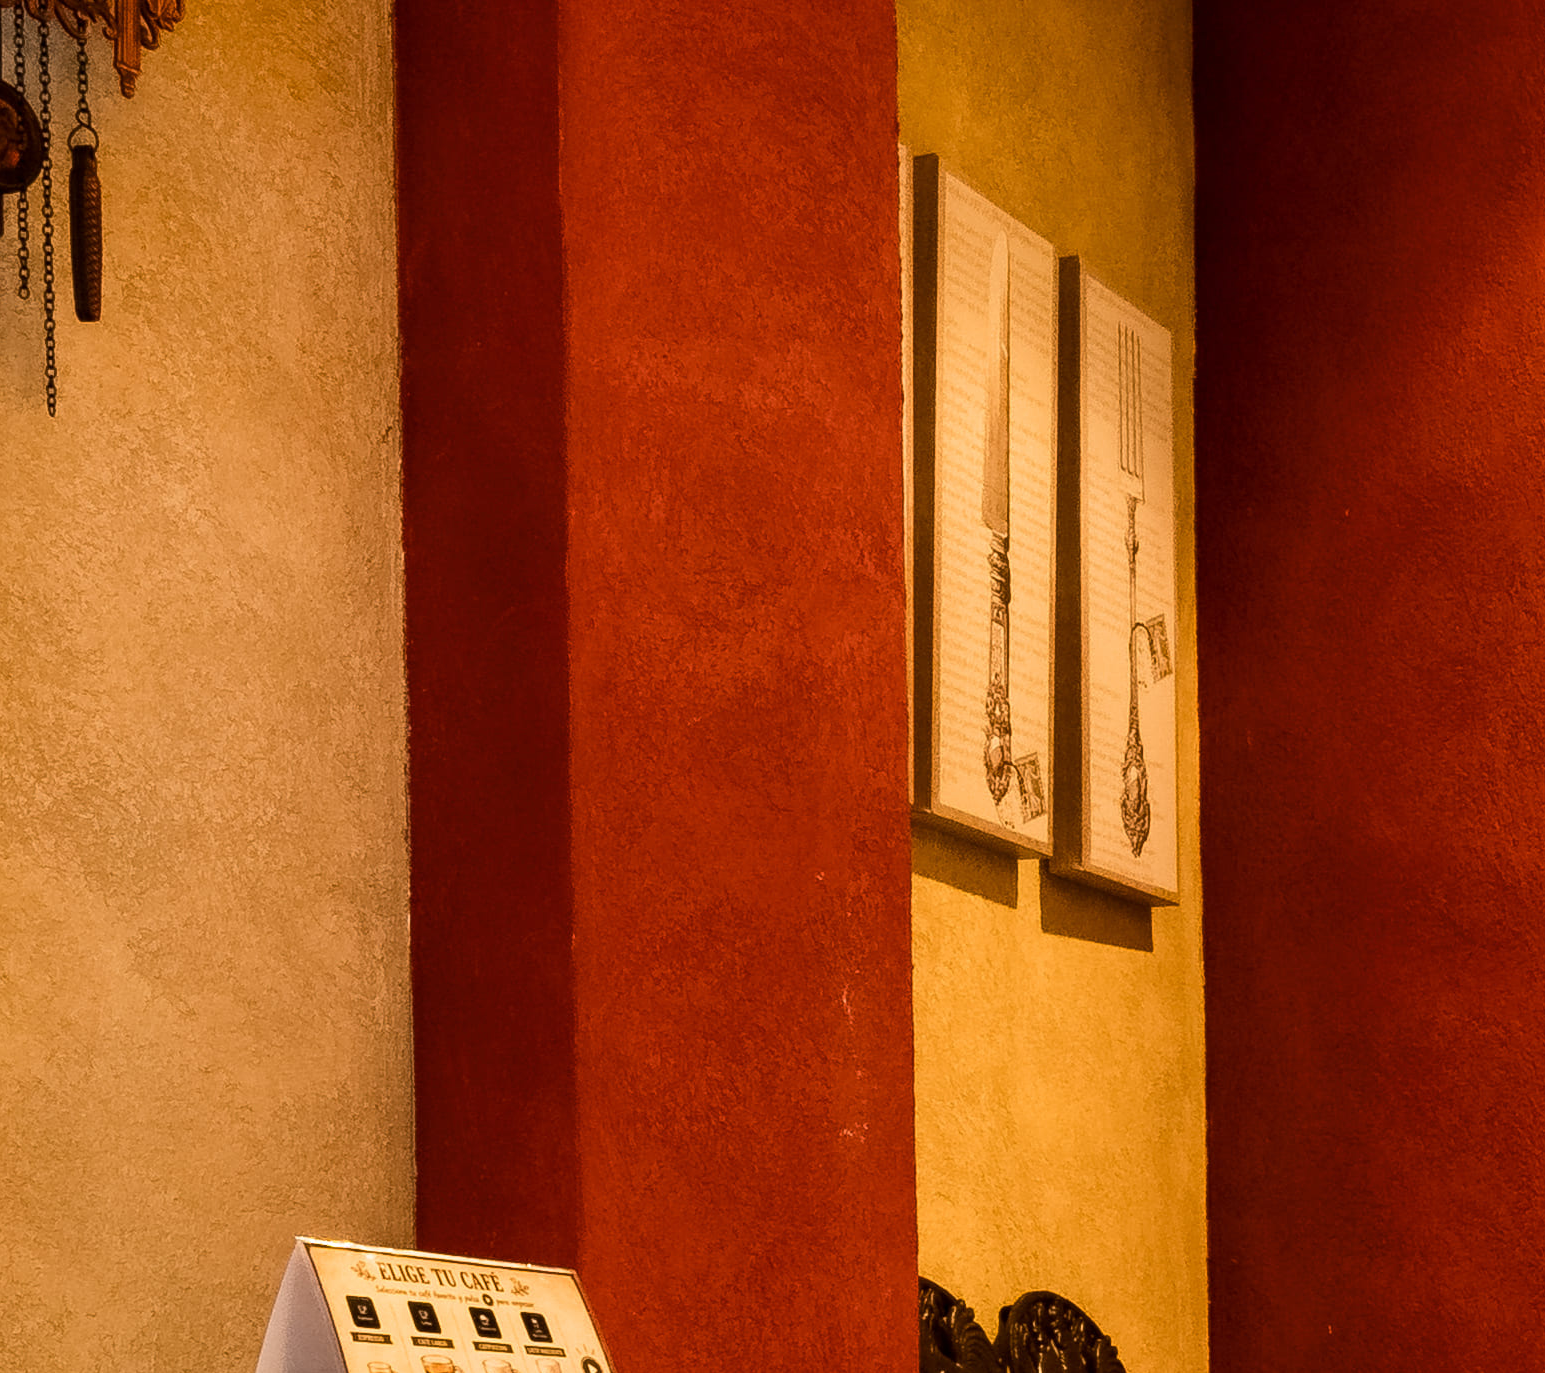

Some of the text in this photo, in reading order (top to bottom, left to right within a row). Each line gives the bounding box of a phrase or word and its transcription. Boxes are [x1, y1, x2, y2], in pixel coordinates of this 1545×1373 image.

[376, 1262, 504, 1292] ELIGE TU CAFÉ
